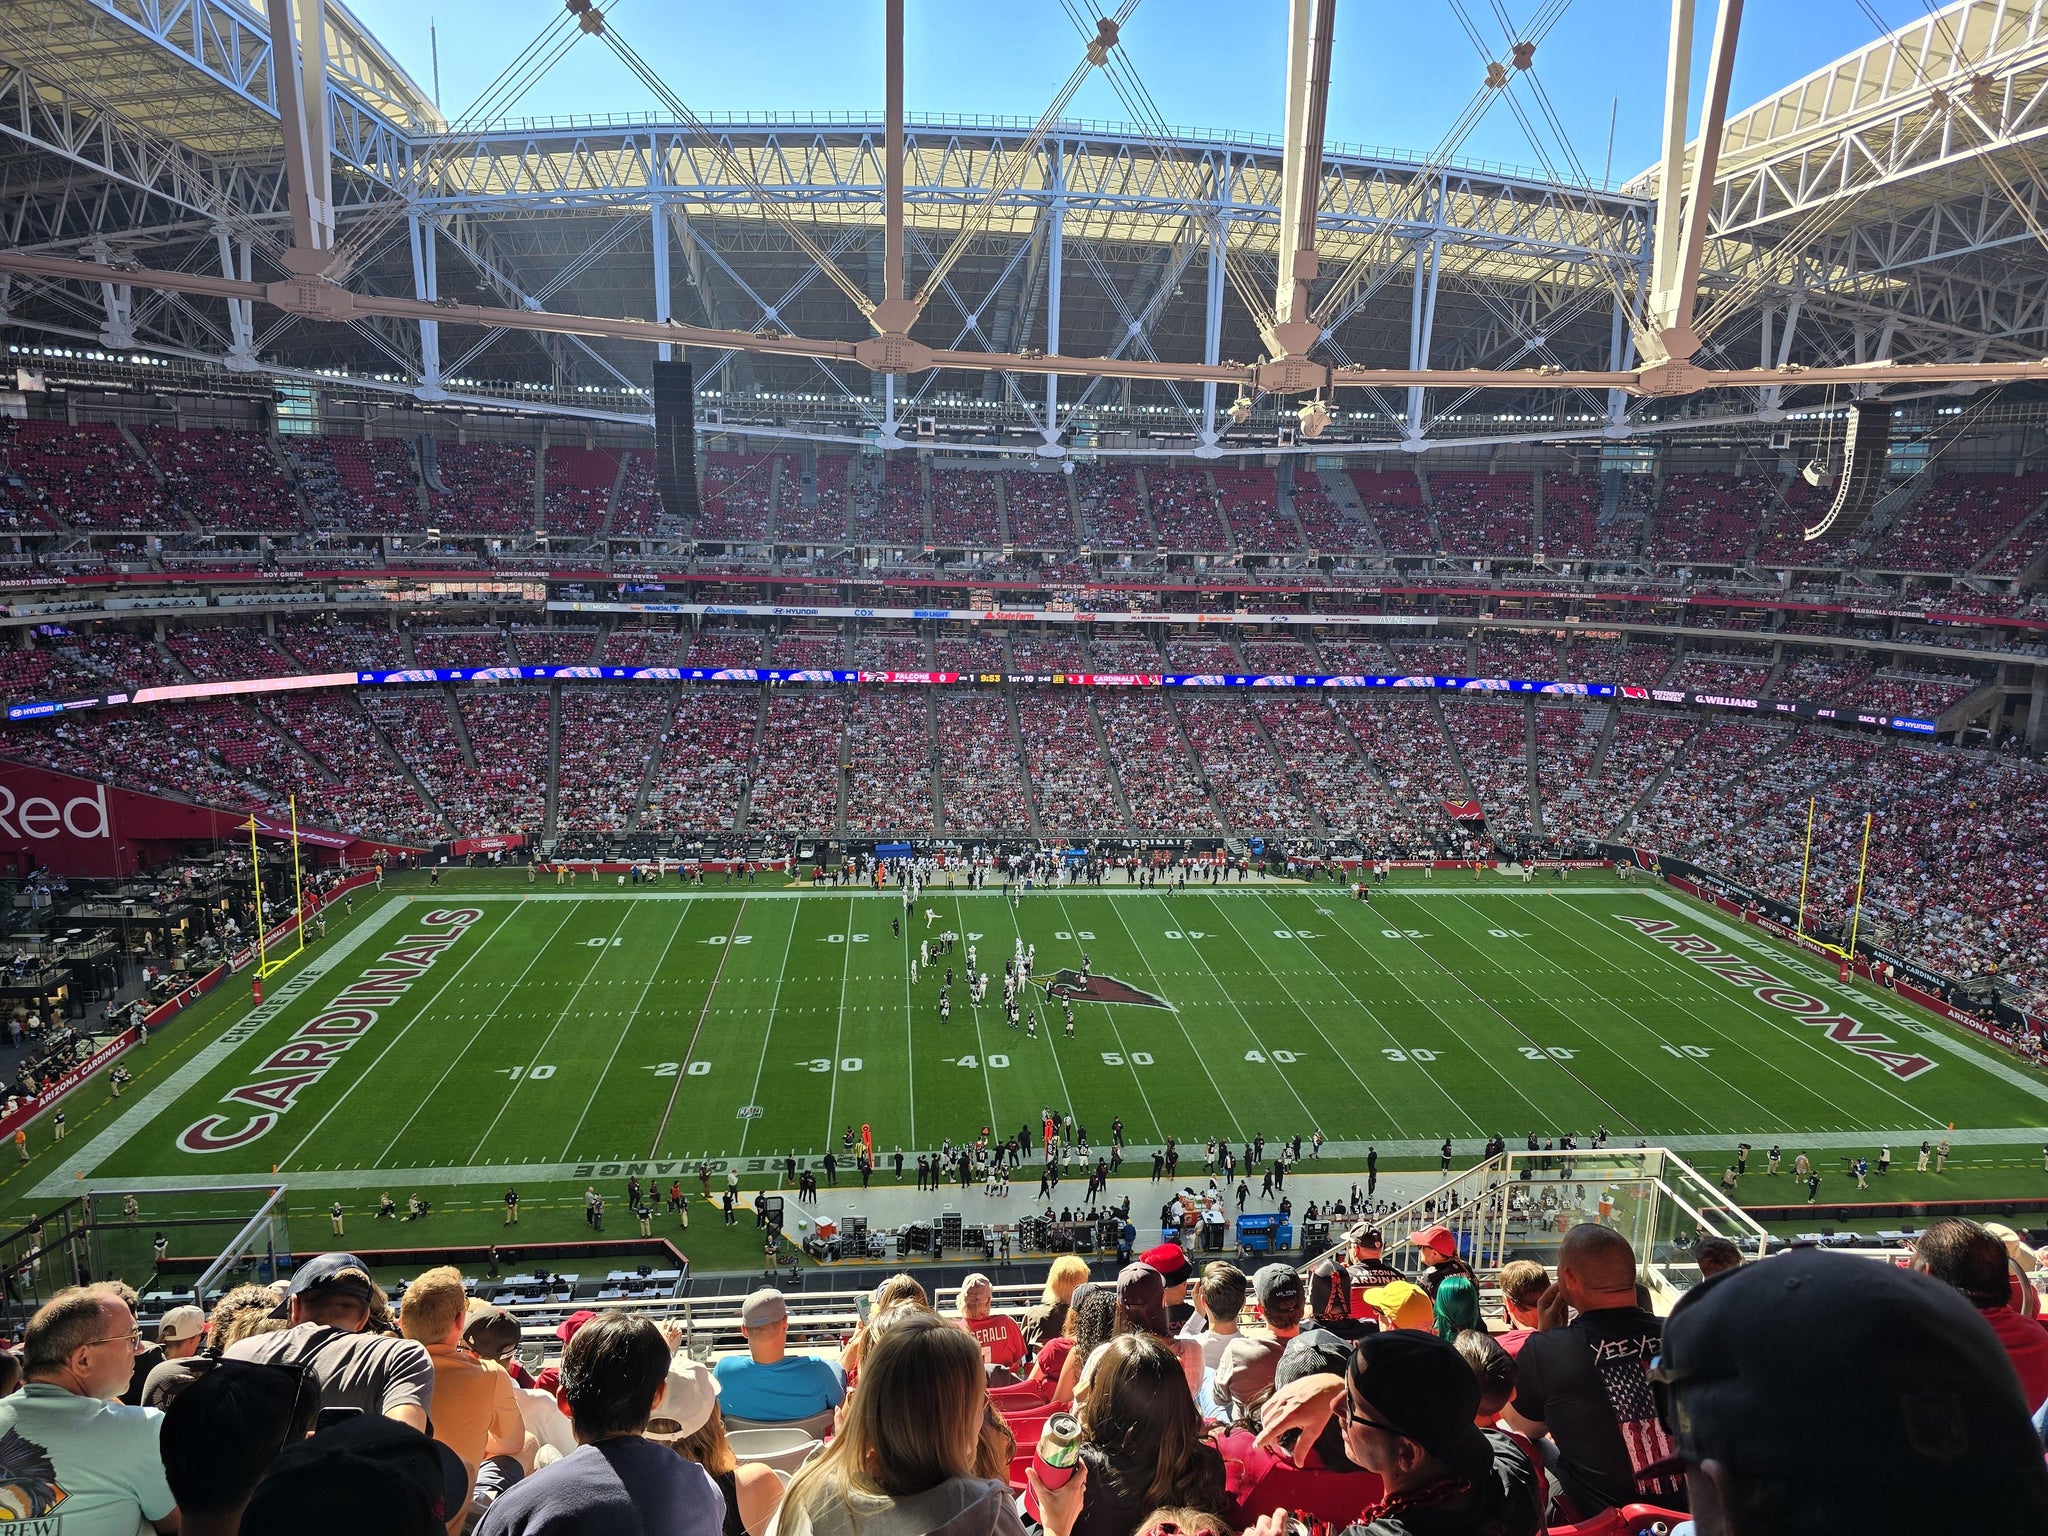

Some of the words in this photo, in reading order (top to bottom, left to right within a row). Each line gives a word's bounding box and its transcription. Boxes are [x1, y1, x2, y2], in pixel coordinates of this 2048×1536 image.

[1850, 607, 1887, 615] MARSHALL
[970, 674, 975, 682] 1
[980, 674, 1001, 682] 9:53
[1652, 690, 1686, 698] DEFENSIVE
[1695, 695, 1758, 708] G.WILLIAMS
[23, 704, 54, 715] HYUNDAI
[1858, 715, 1876, 724] SACK
[1904, 722, 1935, 731] HYUNDAI
[278, 828, 347, 845] verizon
[1873, 950, 1904, 969] ARIZONA
[1905, 965, 1946, 988] CARDINALS
[1611, 913, 1940, 1082] ARIZONA
[1764, 949, 1828, 980] TAKES
[1823, 980, 1864, 999] ALL
[1862, 1000, 1896, 1016] OF
[1892, 1016, 1933, 1033] US
[219, 998, 289, 1044] CHOOSE
[278, 969, 324, 996] LOVE
[1947, 1010, 1990, 1035] ARIZONA
[176, 908, 484, 1154] CARDINALS
[1100, 1051, 1155, 1066] 50
[1244, 1049, 1298, 1064] 40
[1380, 1047, 1436, 1062] 30
[1517, 1045, 1575, 1060] 20
[1659, 1044, 1710, 1058] 10
[655, 1060, 712, 1076] 20
[809, 1057, 864, 1073] 30
[956, 1053, 1011, 1068] 40
[38, 1075, 79, 1107] ARIZONA
[81, 1039, 126, 1077] CARDINALS
[508, 1064, 558, 1081] 10
[574, 1160, 728, 1178] CHANGE
[1590, 1339, 1639, 1366] YEE
[0, 1519, 56, 1536] REW
